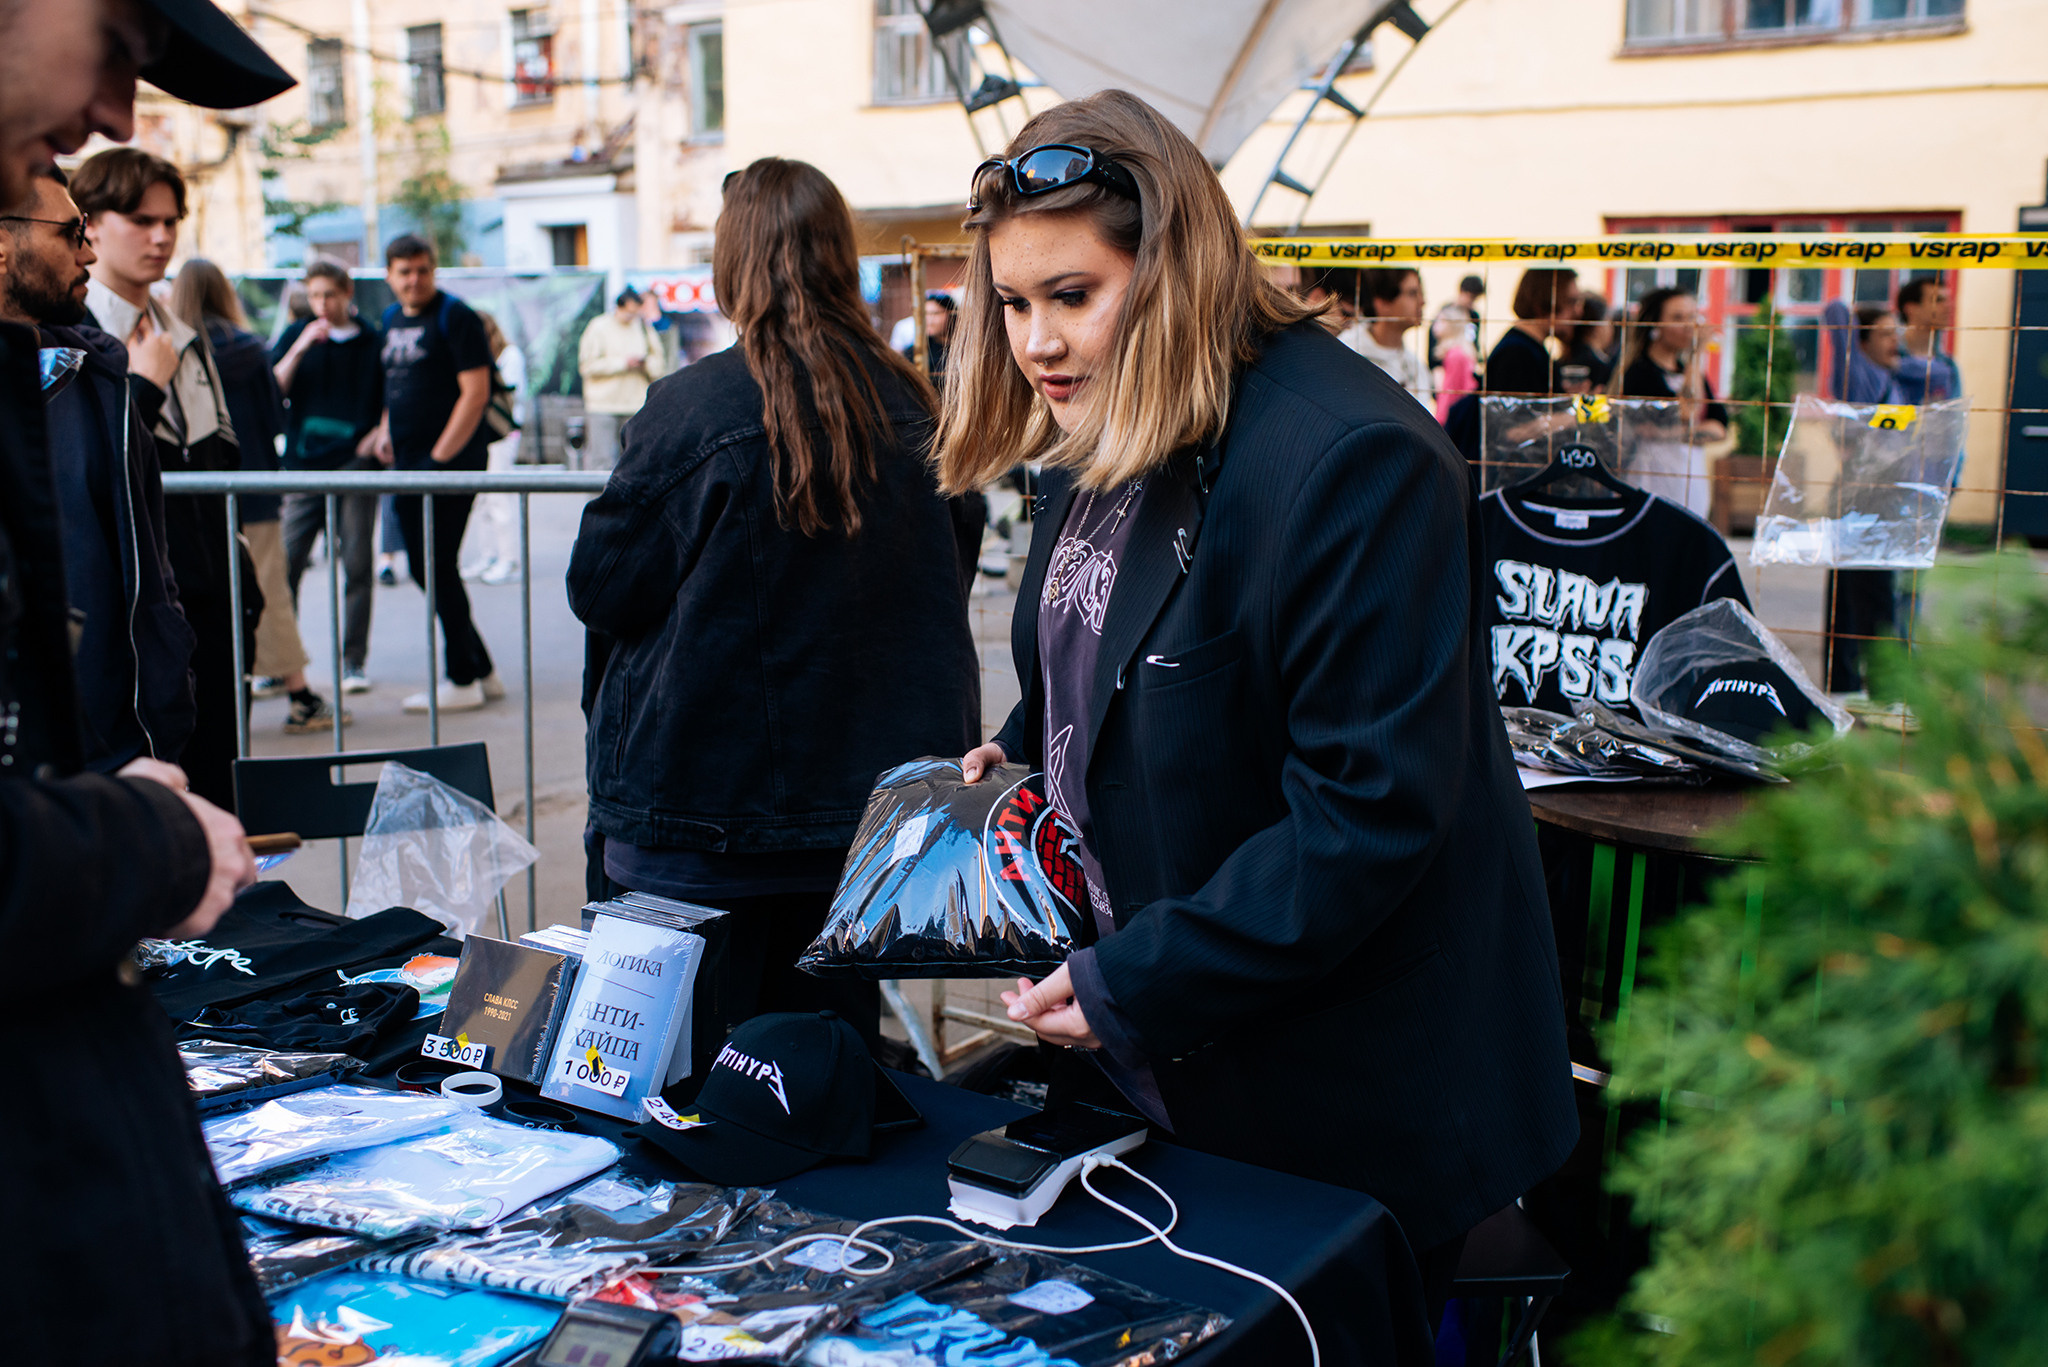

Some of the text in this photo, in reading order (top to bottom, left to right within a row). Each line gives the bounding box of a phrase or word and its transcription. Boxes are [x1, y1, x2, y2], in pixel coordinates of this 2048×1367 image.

[1330, 243, 1396, 262] vsrap
[1414, 243, 1484, 262] vsrap
[1503, 243, 1577, 262] vsrap
[1598, 242, 1675, 262] vsrap
[1696, 242, 1777, 262] vsrap
[1800, 241, 1886, 263] vsrap
[1909, 241, 2000, 263] vsrap
[1560, 448, 1597, 468] 430
[1494, 559, 1650, 642] SLAVA
[1490, 624, 1638, 709] KPSS
[995, 788, 1044, 882] АНТИ
[597, 950, 663, 977] ЛОГИКА
[483, 992, 519, 1010] СЛАВА КПСС
[483, 1006, 512, 1021] 1990-2021
[579, 999, 645, 1031] АНТИ-
[566, 1027, 642, 1061] ХАЙПА
